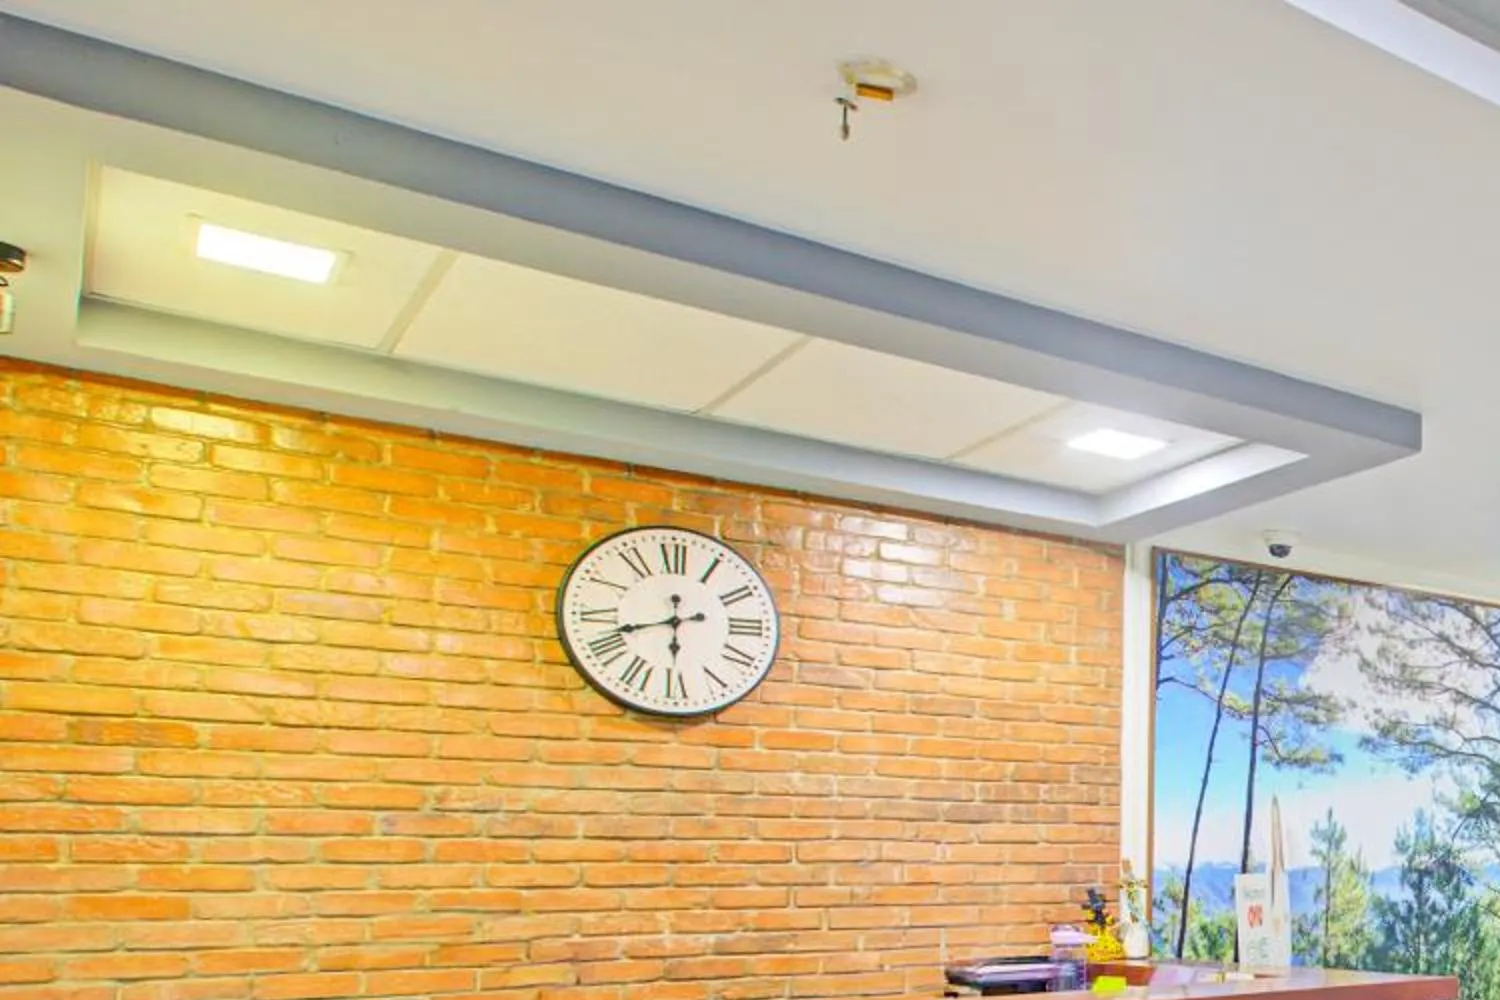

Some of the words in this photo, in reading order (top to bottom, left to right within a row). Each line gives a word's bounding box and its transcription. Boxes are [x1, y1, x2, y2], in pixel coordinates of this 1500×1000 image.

[660, 543, 687, 576] XII
[700, 557, 721, 584] I
[719, 584, 753, 606] II
[728, 617, 763, 637] III
[620, 655, 653, 692] VII
[665, 667, 689, 699] VI
